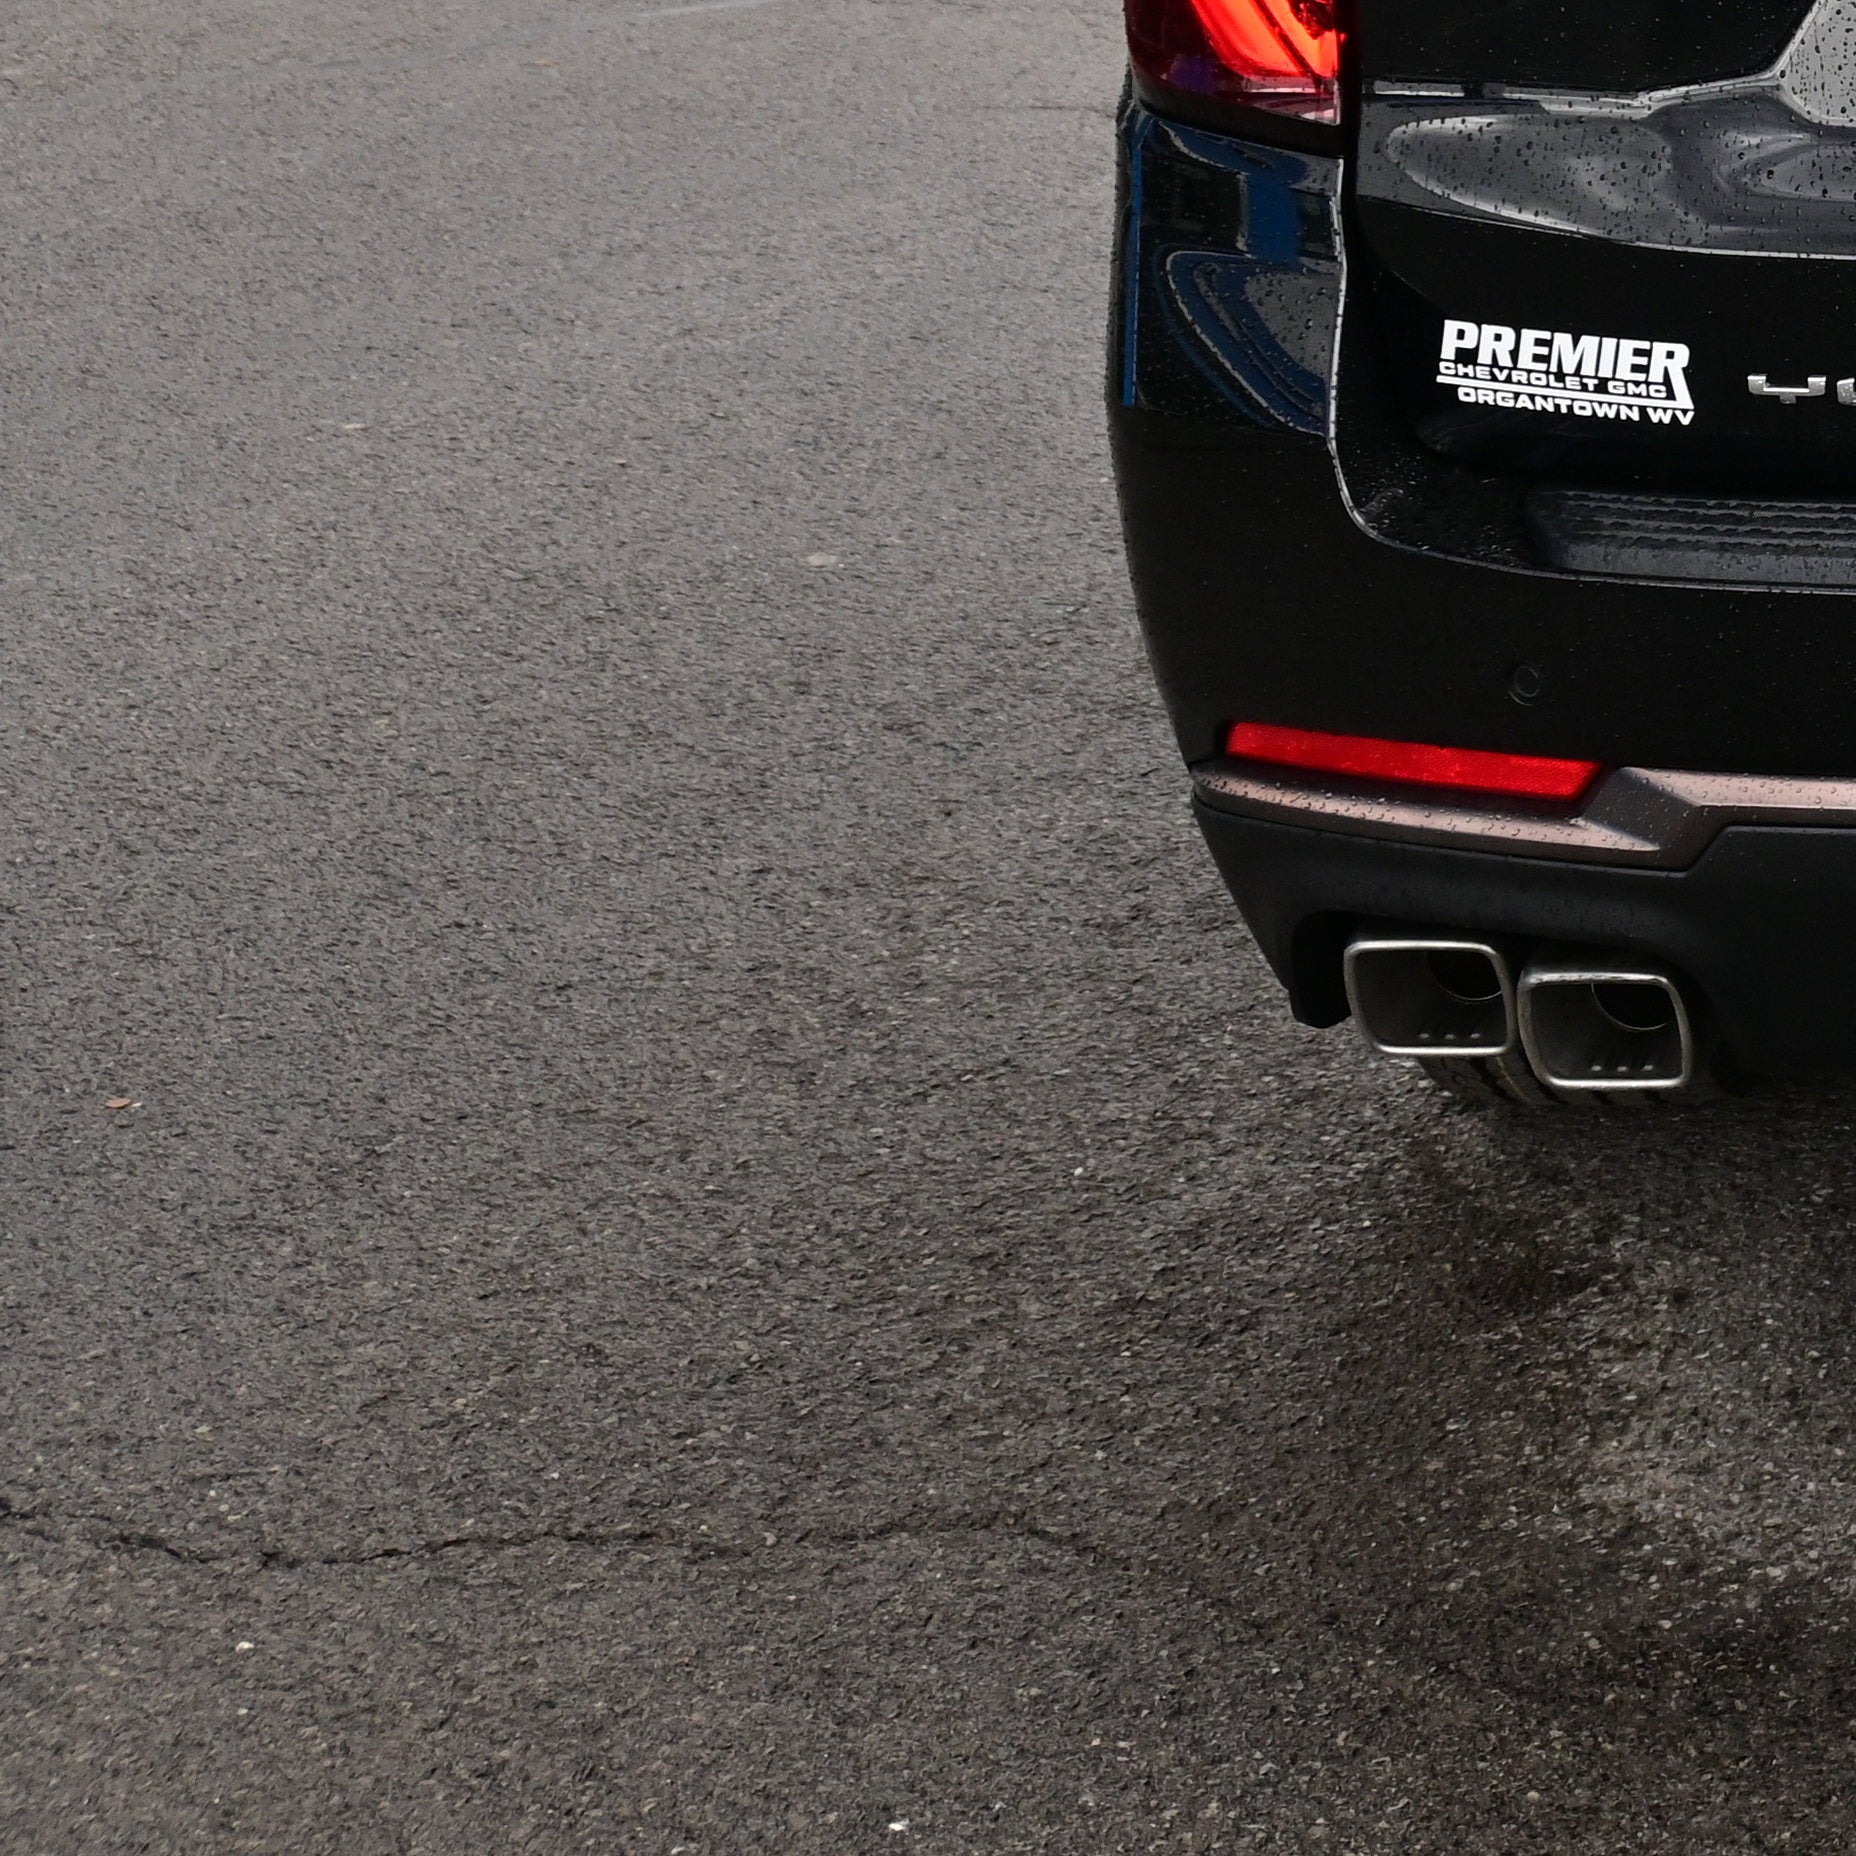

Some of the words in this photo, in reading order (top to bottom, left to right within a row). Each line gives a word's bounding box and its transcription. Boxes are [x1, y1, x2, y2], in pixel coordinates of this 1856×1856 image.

[1439, 361, 1599, 391] CHEVROLET
[1607, 381, 1668, 398] GMC
[1440, 319, 1694, 408] PREMIER
[1457, 386, 1640, 422] ORGANTOWN
[1646, 407, 1694, 426] WV
